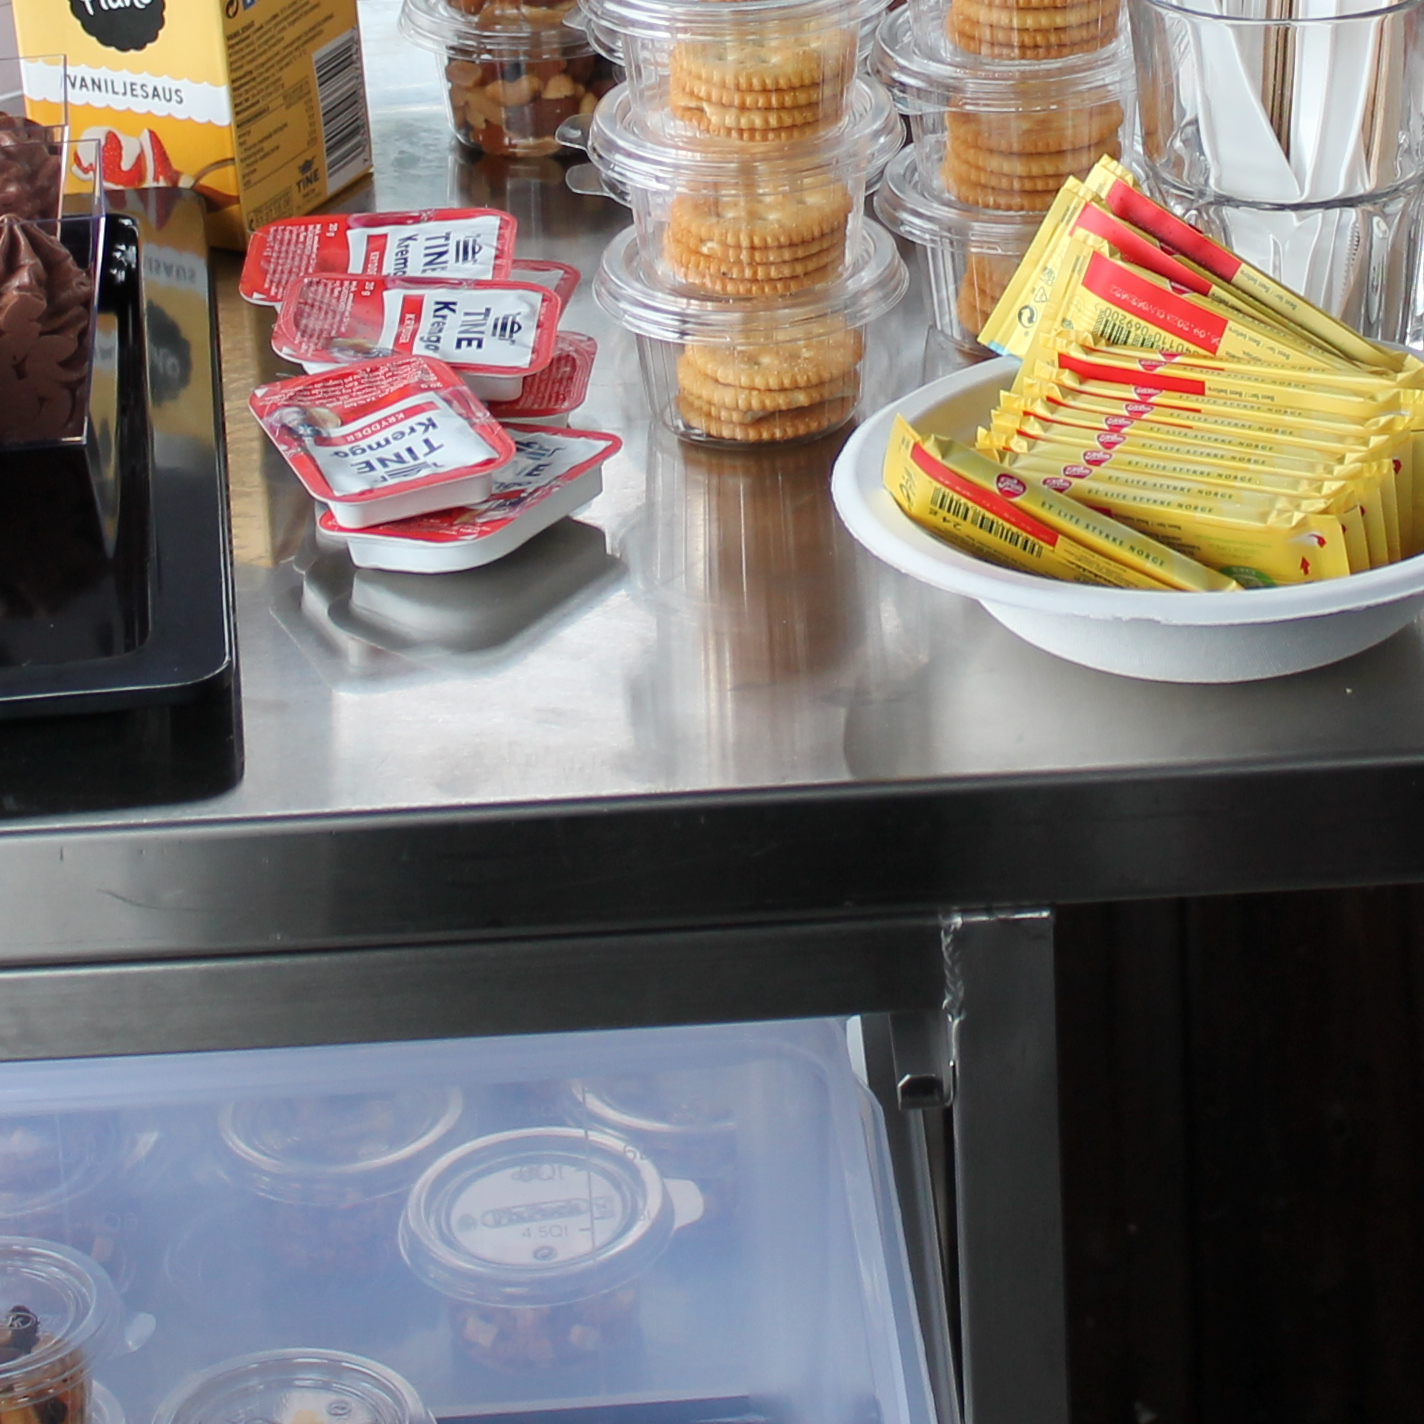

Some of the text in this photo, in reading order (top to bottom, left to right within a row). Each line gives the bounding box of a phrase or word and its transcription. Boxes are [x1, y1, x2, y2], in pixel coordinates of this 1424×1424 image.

[67, 74, 184, 105] VANILJESAUS
[296, 168, 320, 193] TINE
[455, 307, 491, 351] TINE
[1103, 307, 1149, 338] 069200
[345, 412, 406, 443] KRYDDER
[1166, 428, 1188, 438] LITE
[1238, 440, 1274, 452] NORGE
[351, 439, 444, 475] TINE
[1159, 444, 1181, 453] LITE
[1186, 448, 1225, 460] STYKKE
[1231, 455, 1267, 466] NORGE
[1128, 459, 1253, 483] ET LITE STYKKE NORGE
[1087, 487, 1213, 514] ET LITE STYKKE NORGE
[1108, 475, 1234, 500] ET LITE STYKKE NORGE
[1041, 501, 1054, 512] ET
[1058, 508, 1080, 526] LITE
[1085, 522, 1125, 548] STYKKE
[1129, 542, 1166, 568] NORGE
